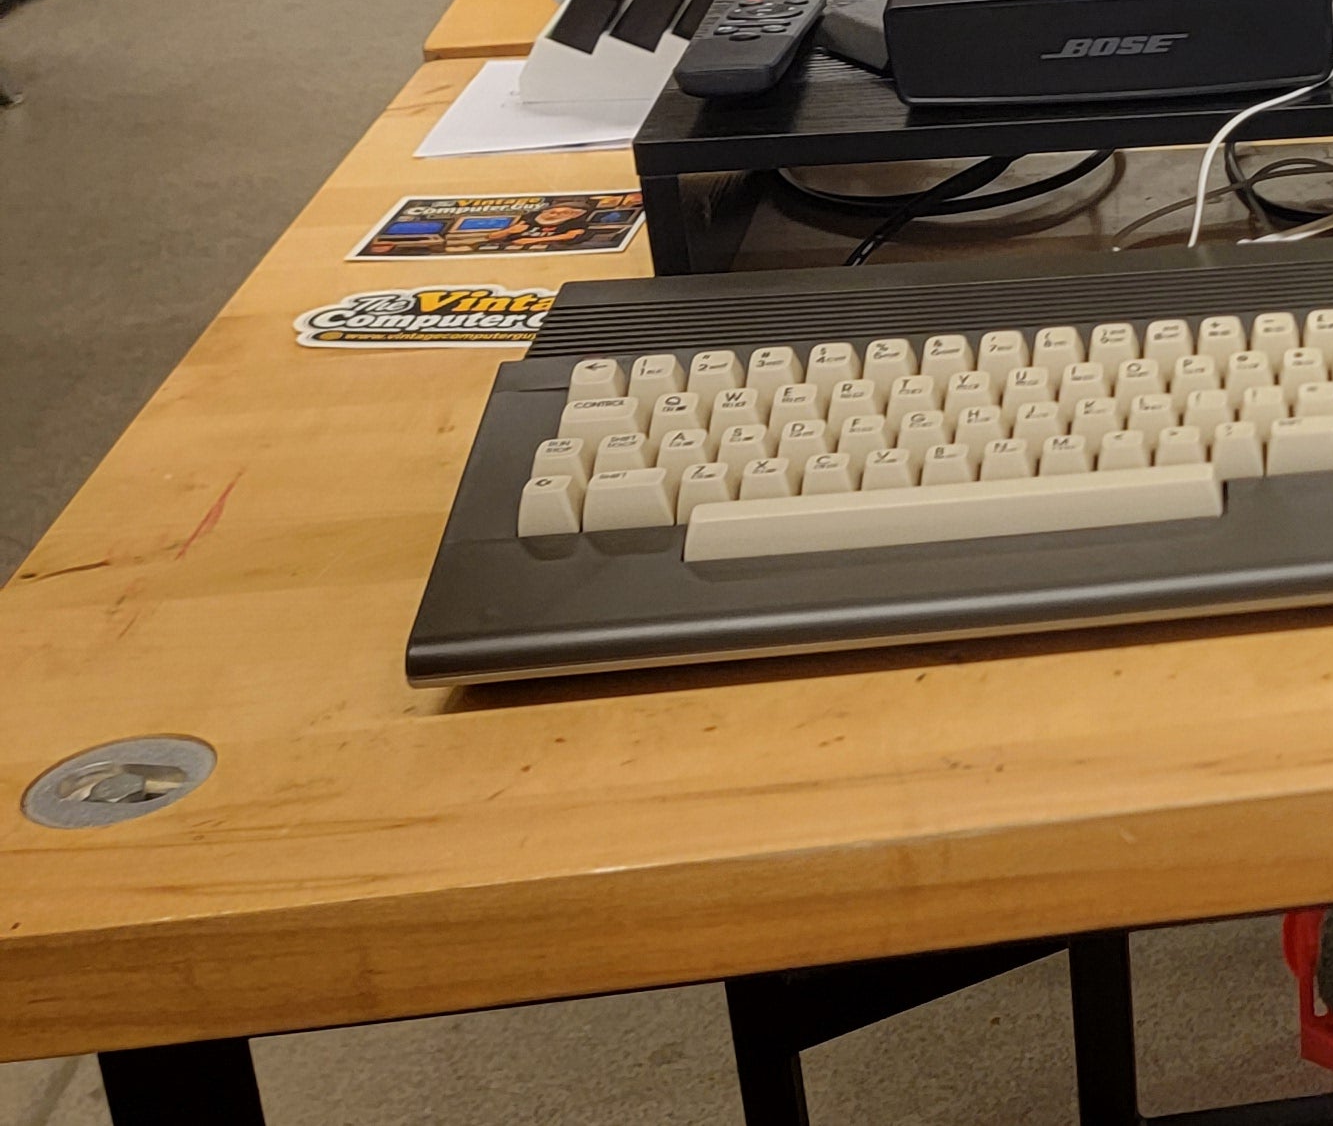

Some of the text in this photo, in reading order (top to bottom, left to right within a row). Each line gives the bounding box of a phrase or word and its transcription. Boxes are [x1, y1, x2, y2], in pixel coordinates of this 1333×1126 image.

[1041, 33, 1189, 60] BOSE
[455, 196, 543, 208] Vintage
[406, 205, 512, 216] Computer
[352, 296, 411, 313] The
[312, 309, 522, 331] Computer
[725, 391, 744, 402] W
[574, 399, 624, 409] CONTROL
